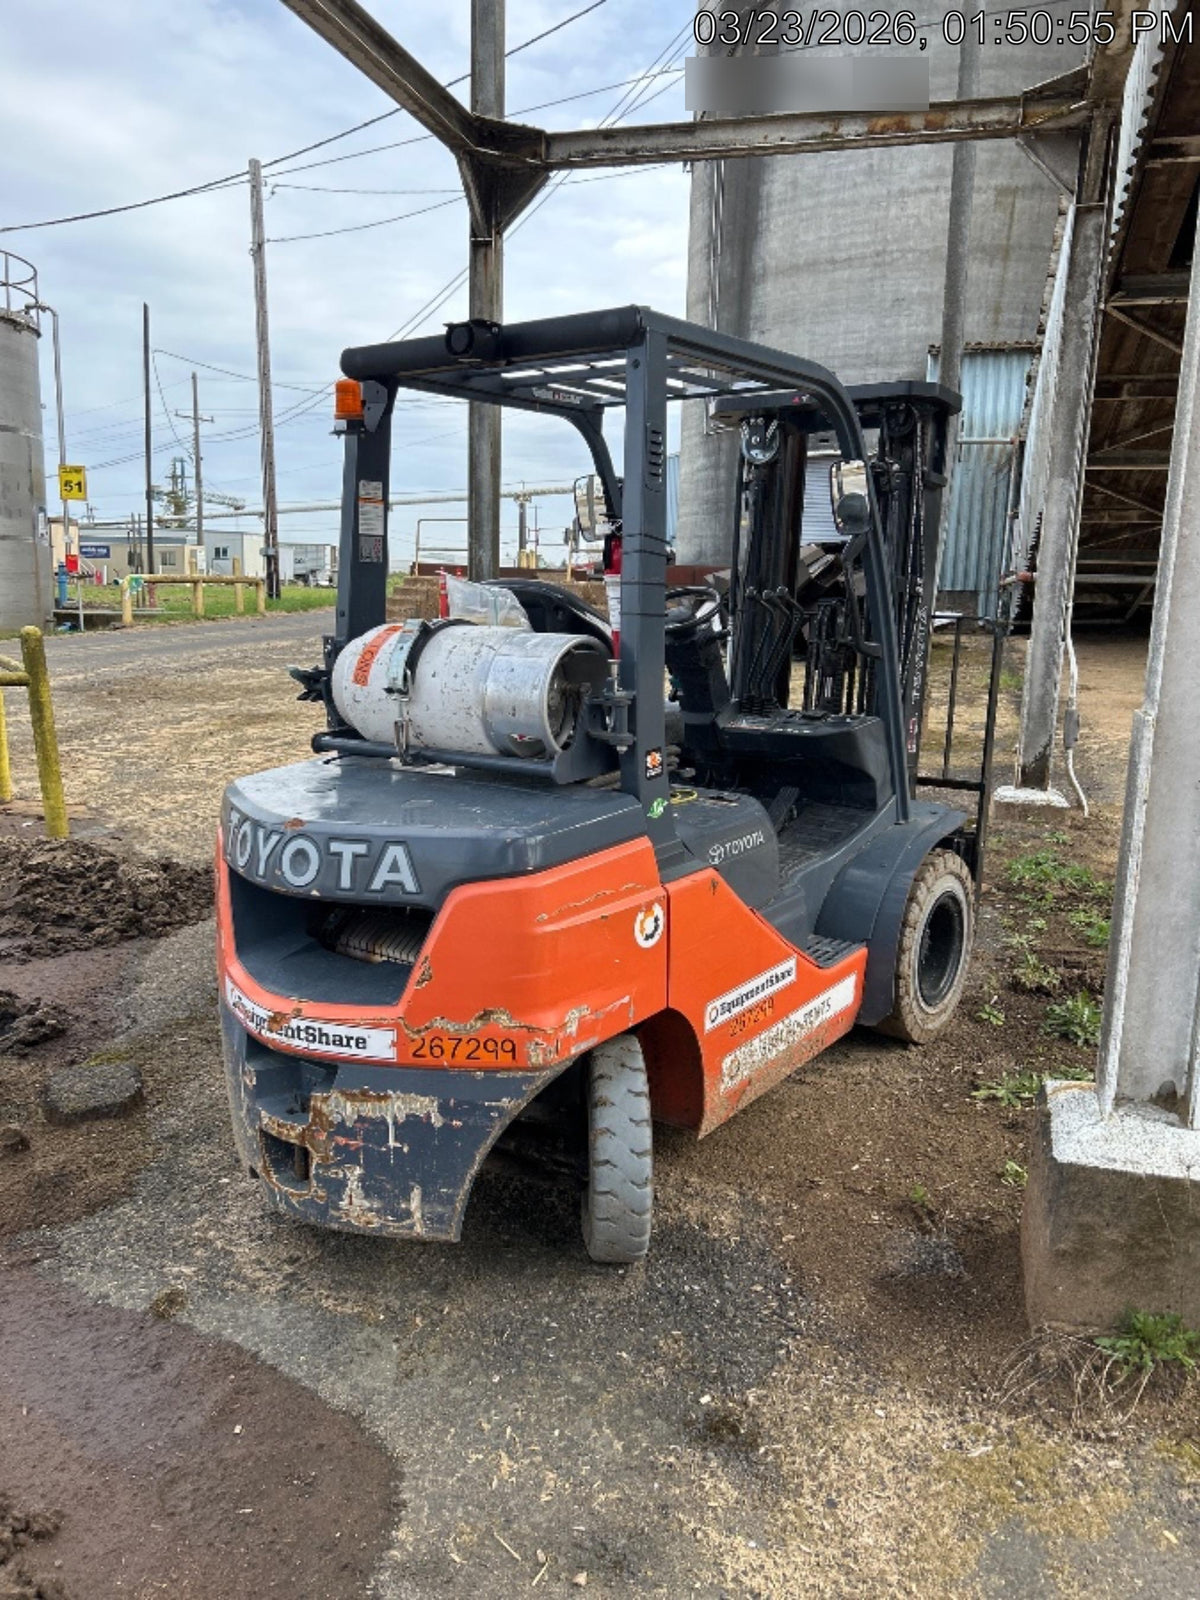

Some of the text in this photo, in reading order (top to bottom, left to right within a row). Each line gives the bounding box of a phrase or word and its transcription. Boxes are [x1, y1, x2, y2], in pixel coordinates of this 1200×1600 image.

[228, 809, 421, 893] TOYOTA
[725, 831, 765, 855] TOYOTA
[719, 968, 793, 1016] EquipmentShare
[412, 1036, 518, 1061] 267299
